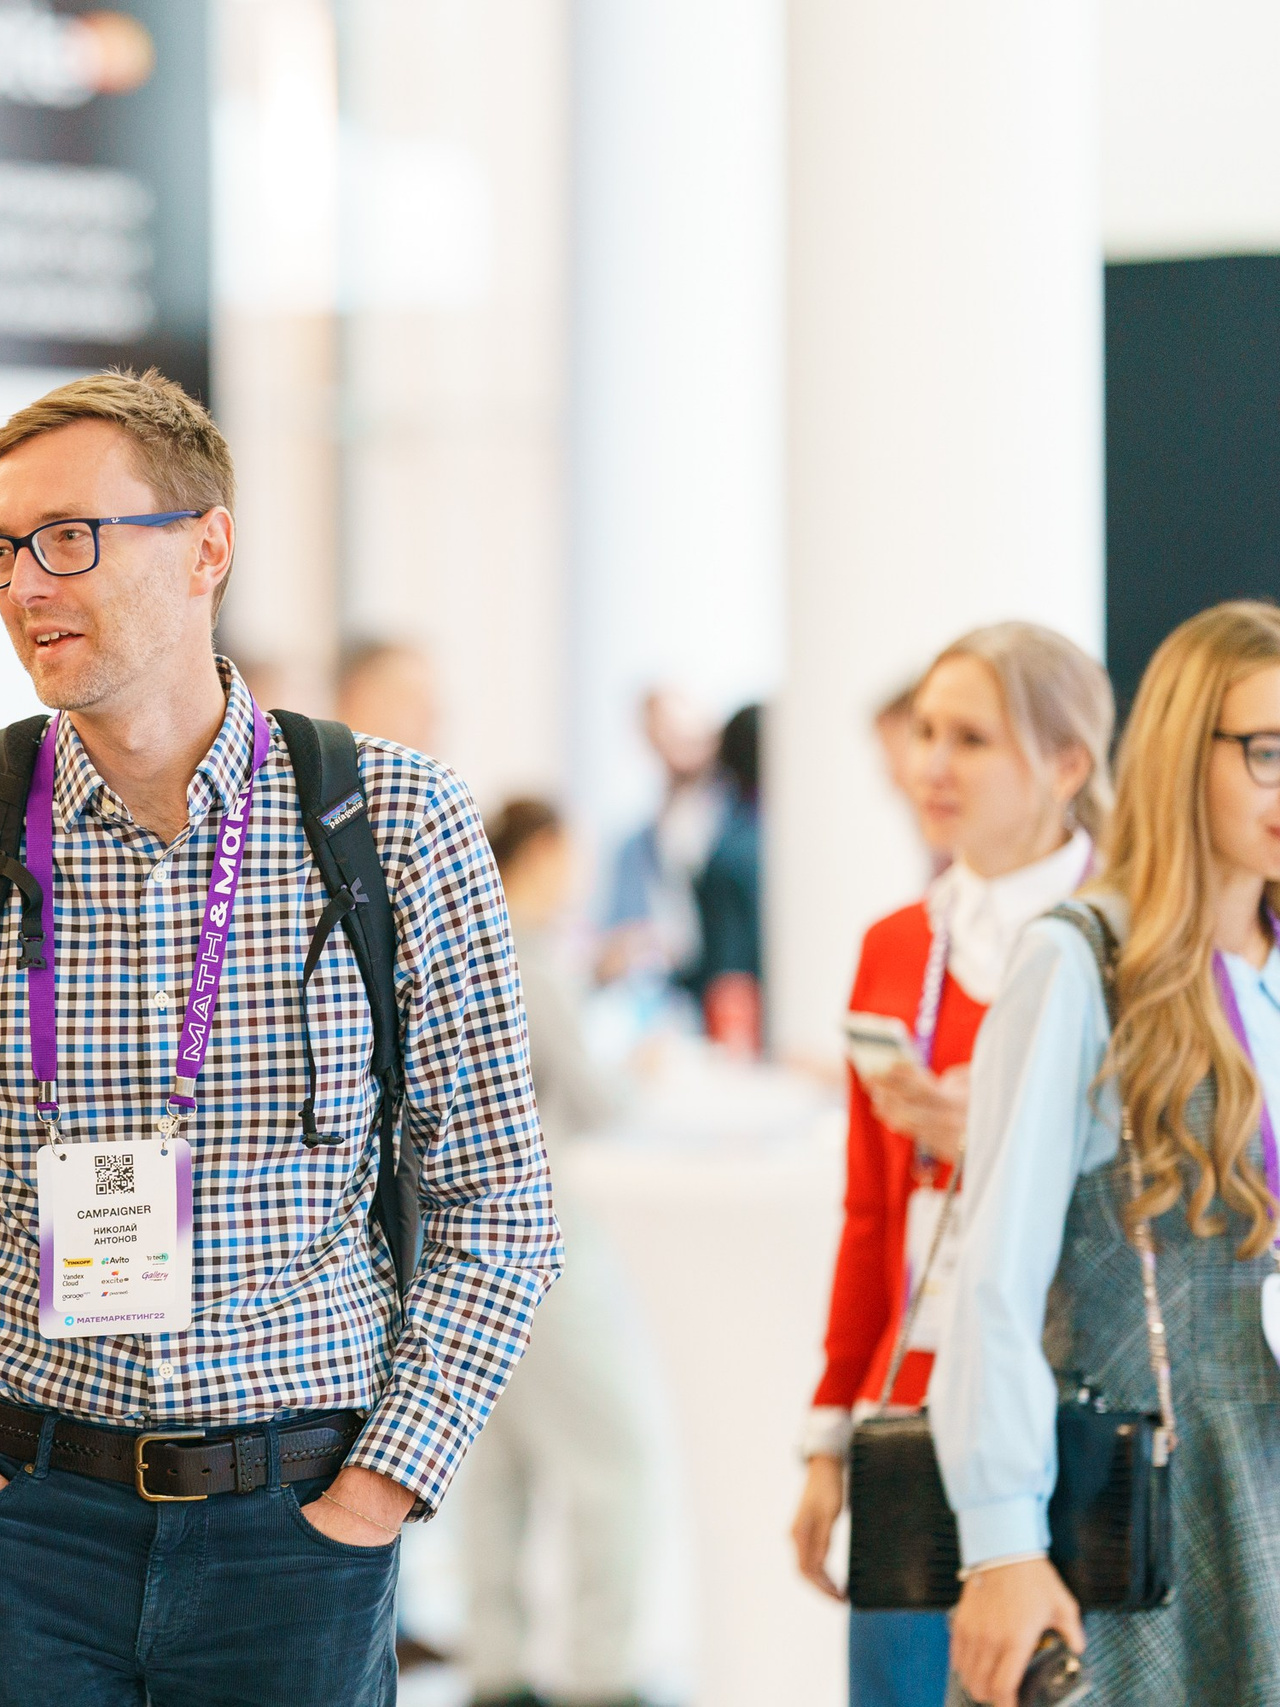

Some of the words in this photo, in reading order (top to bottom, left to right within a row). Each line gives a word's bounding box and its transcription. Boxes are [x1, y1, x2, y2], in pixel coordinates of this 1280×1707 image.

[329, 800, 364, 829] patagonia
[183, 932, 223, 1062] MATH
[209, 900, 229, 928] &
[76, 1204, 152, 1220] CAMPAIGNER
[93, 1223, 138, 1235] НИКОЛАЙ
[93, 1235, 138, 1246] АНТОНОВ
[109, 1256, 130, 1265] Avito
[62, 1273, 85, 1281] Yandex
[101, 1277, 124, 1285] excite
[141, 1270, 169, 1281] Gallery
[62, 1279, 79, 1288] Cloud
[61, 1293, 84, 1302] garage
[76, 1312, 165, 1324] МАТЕМАРКЕТИНГ22
